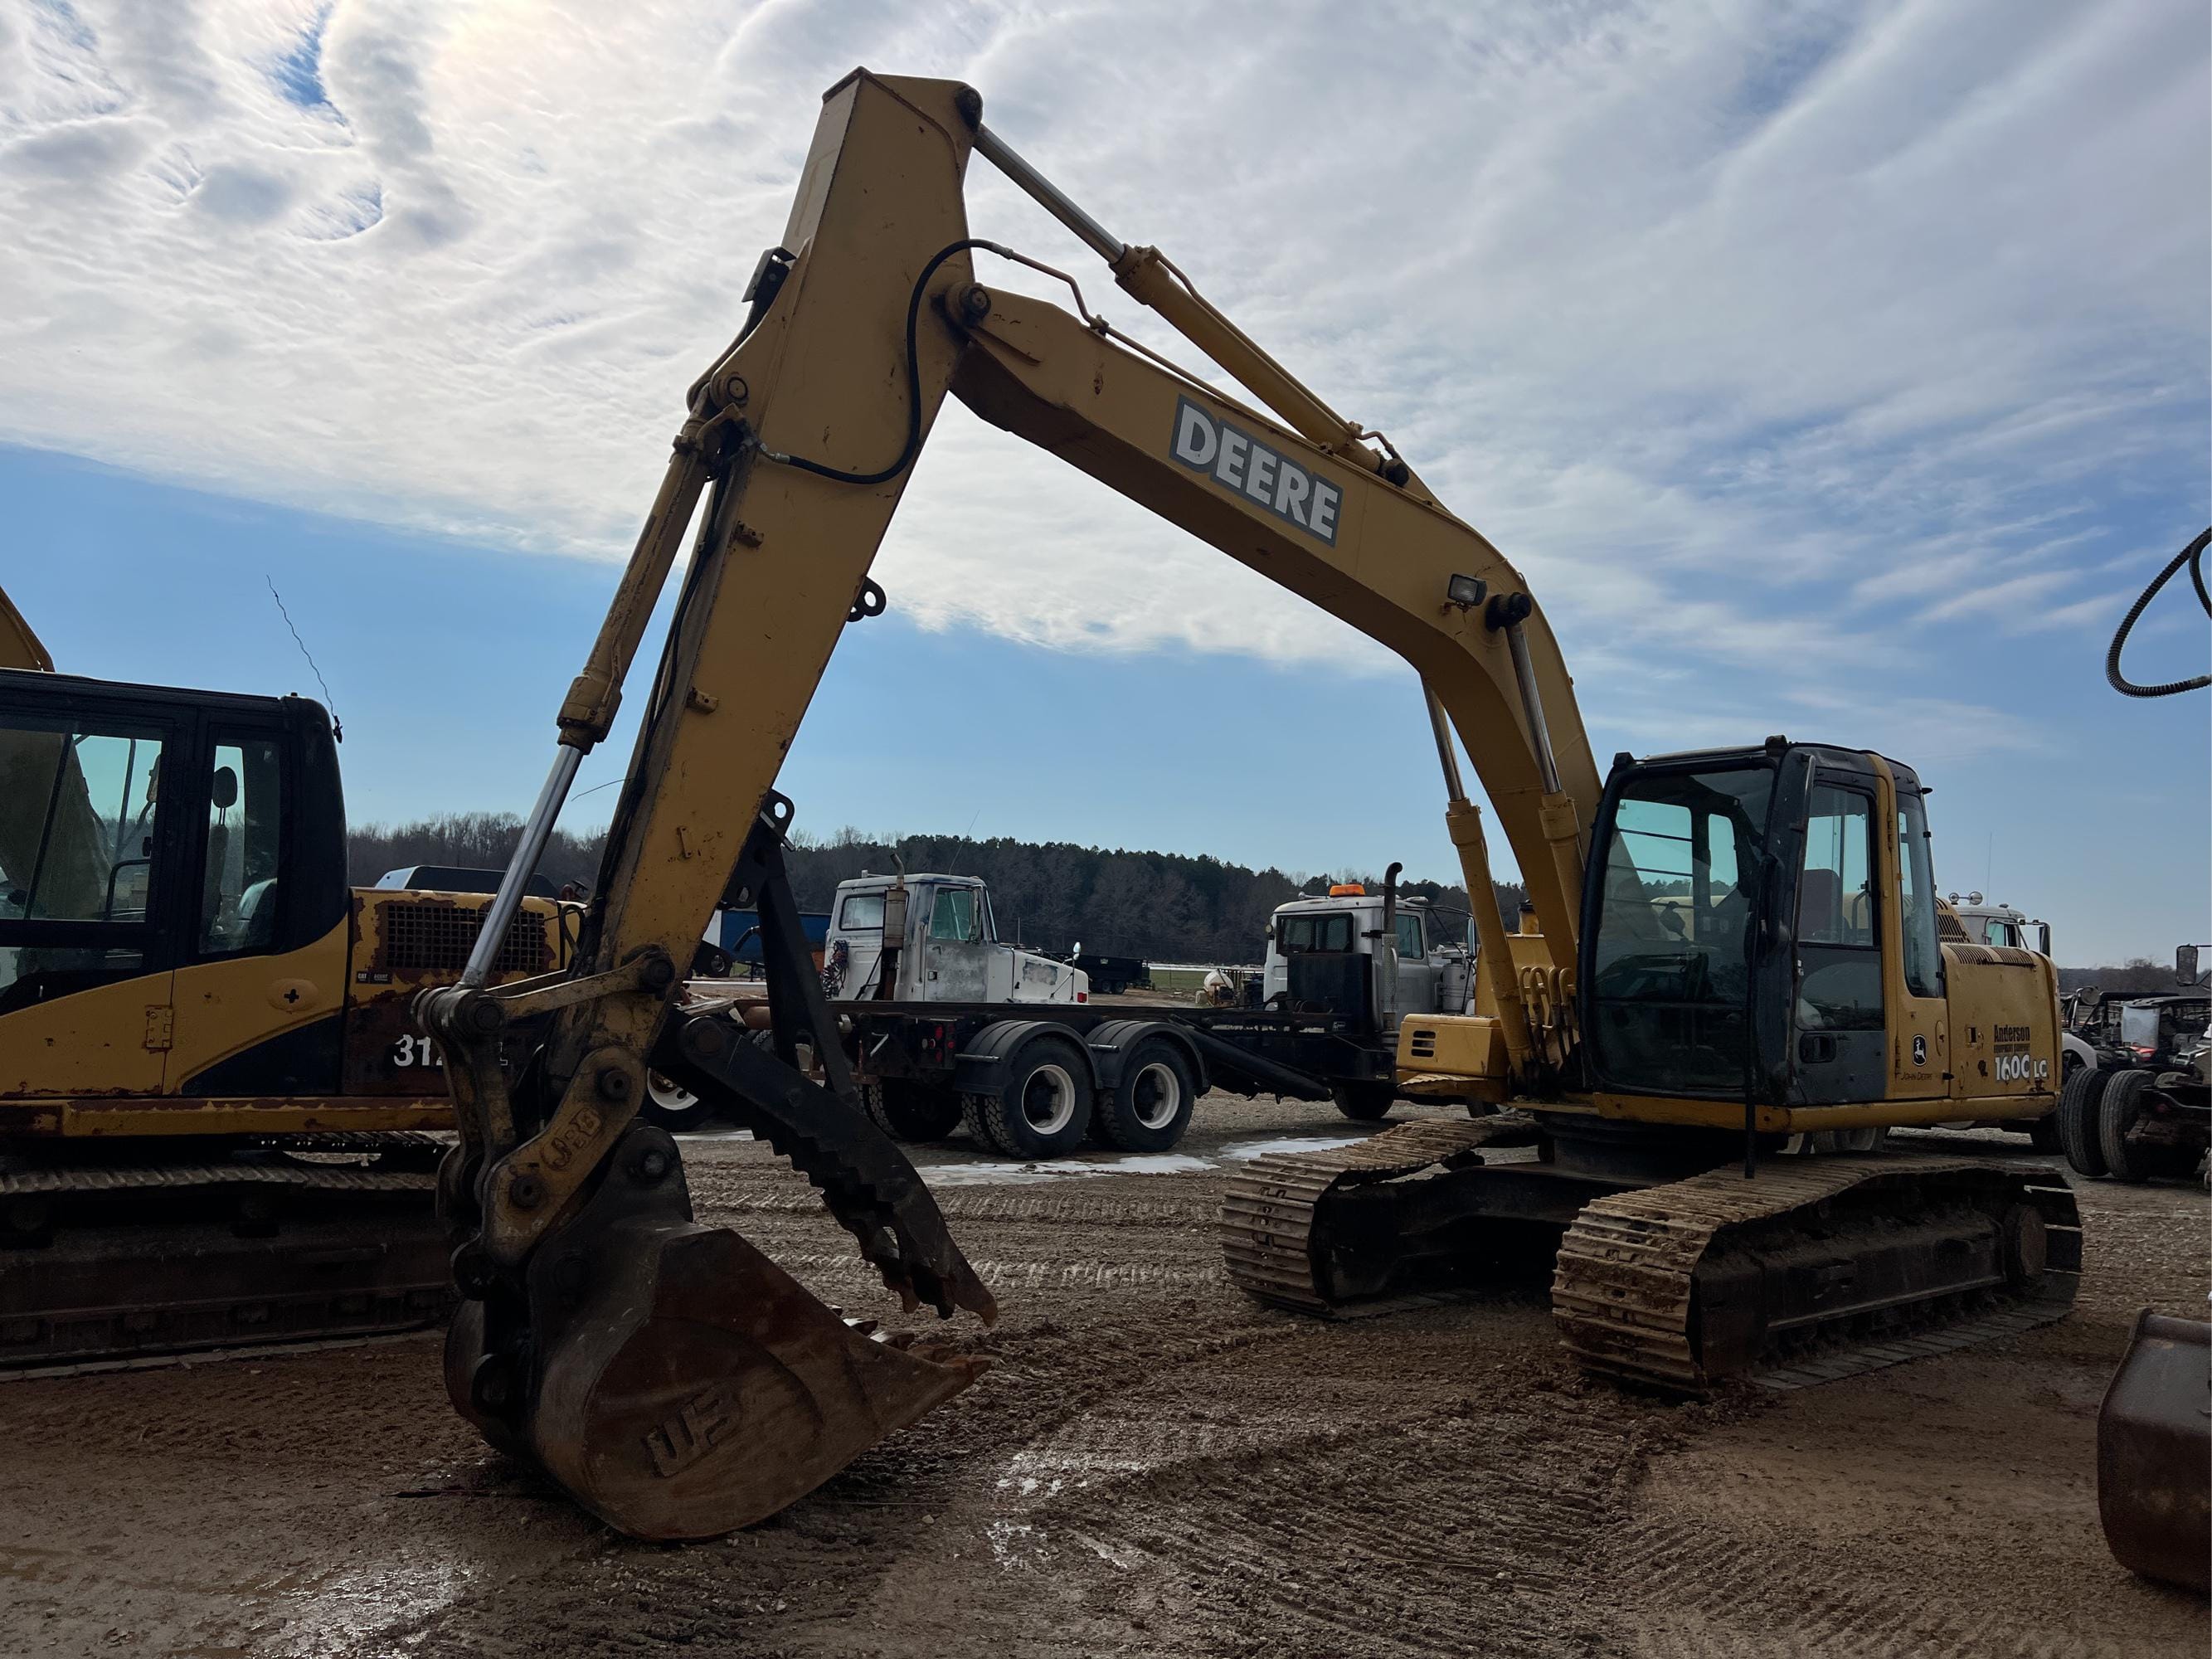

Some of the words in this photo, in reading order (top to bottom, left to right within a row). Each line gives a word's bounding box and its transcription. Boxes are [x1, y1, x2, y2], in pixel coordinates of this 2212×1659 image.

[1176, 403, 1339, 539] DEERE
[1994, 1024, 2030, 1043] Anderson
[393, 1034, 443, 1067] 31
[1995, 1053, 2030, 1081] 160C
[2034, 1059, 2048, 1078] LC
